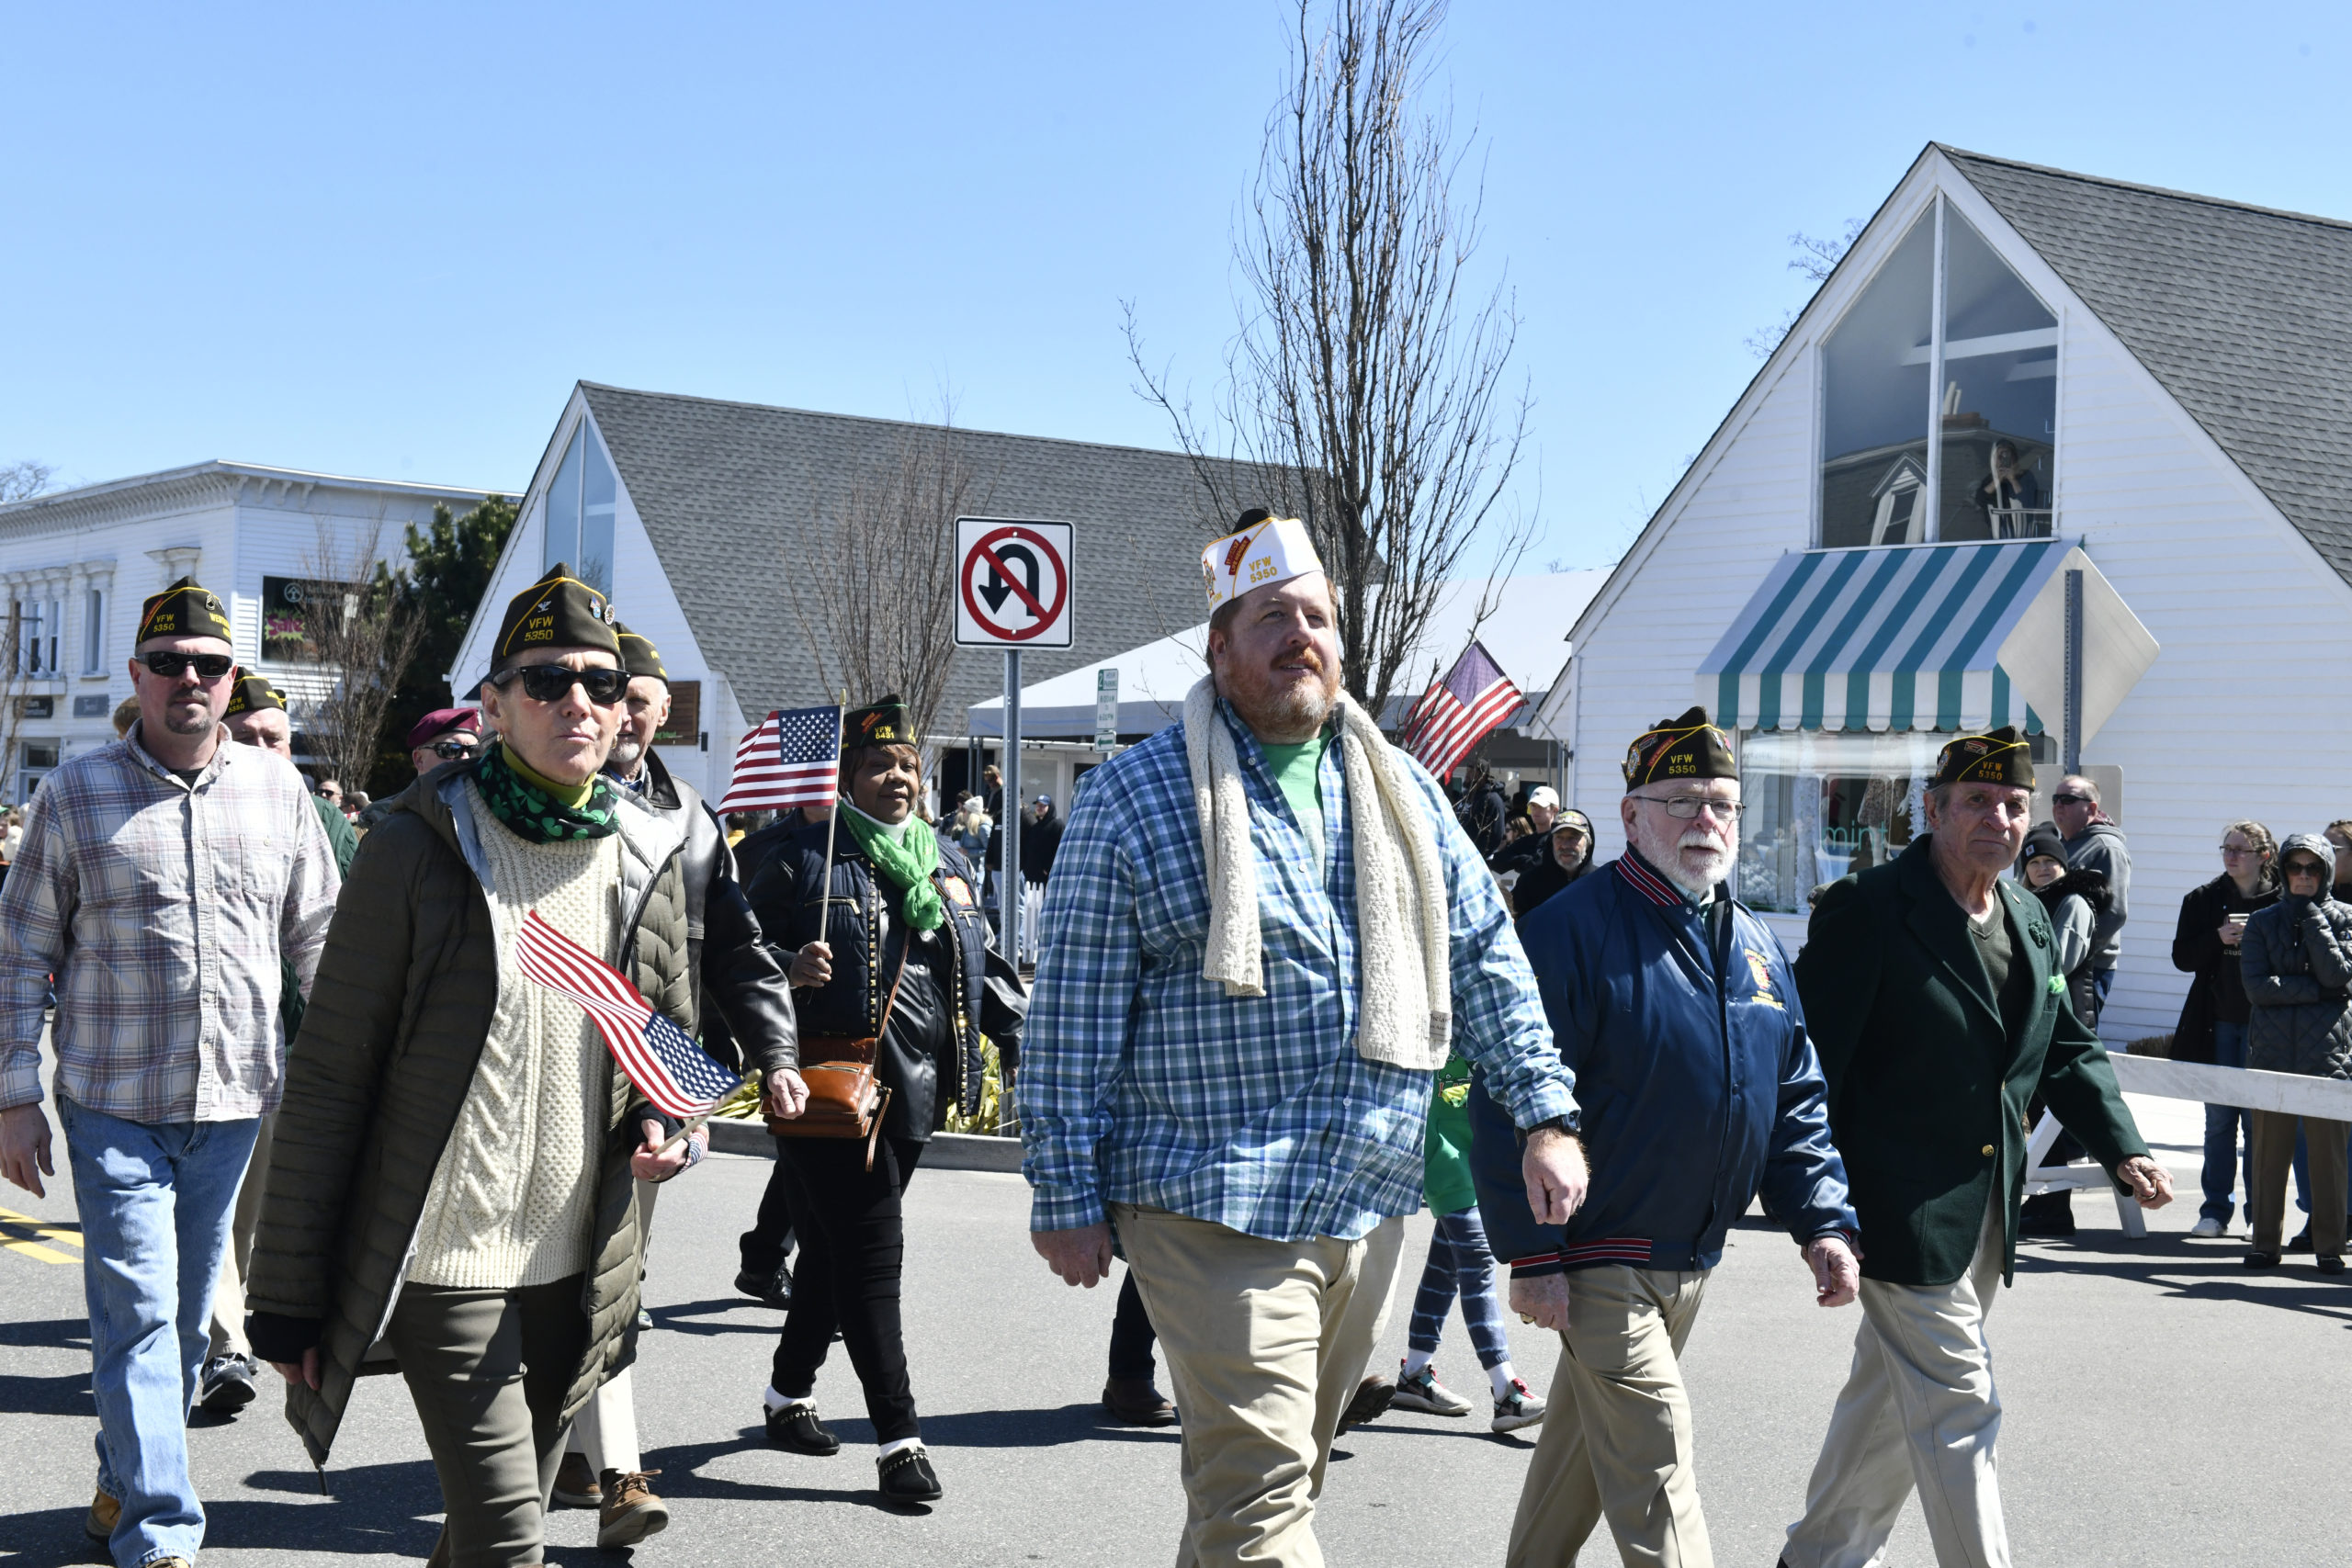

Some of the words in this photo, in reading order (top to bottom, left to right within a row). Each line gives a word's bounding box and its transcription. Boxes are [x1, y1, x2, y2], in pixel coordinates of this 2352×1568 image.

[1249, 556, 1272, 572] VFW
[1250, 566, 1278, 583] 5350
[156, 614, 175, 623] VFW
[529, 615, 554, 629] VFW
[153, 624, 175, 633] 5350
[267, 613, 303, 637] Sale
[524, 629, 554, 642] 5350
[229, 696, 243, 706] VFW
[875, 726, 892, 734] VFW
[1670, 754, 1693, 764] VFW
[1668, 765, 1697, 774] 5350
[1982, 761, 2003, 771] VFW
[1978, 770, 2003, 781] 5350
[1821, 819, 1889, 852] mint
